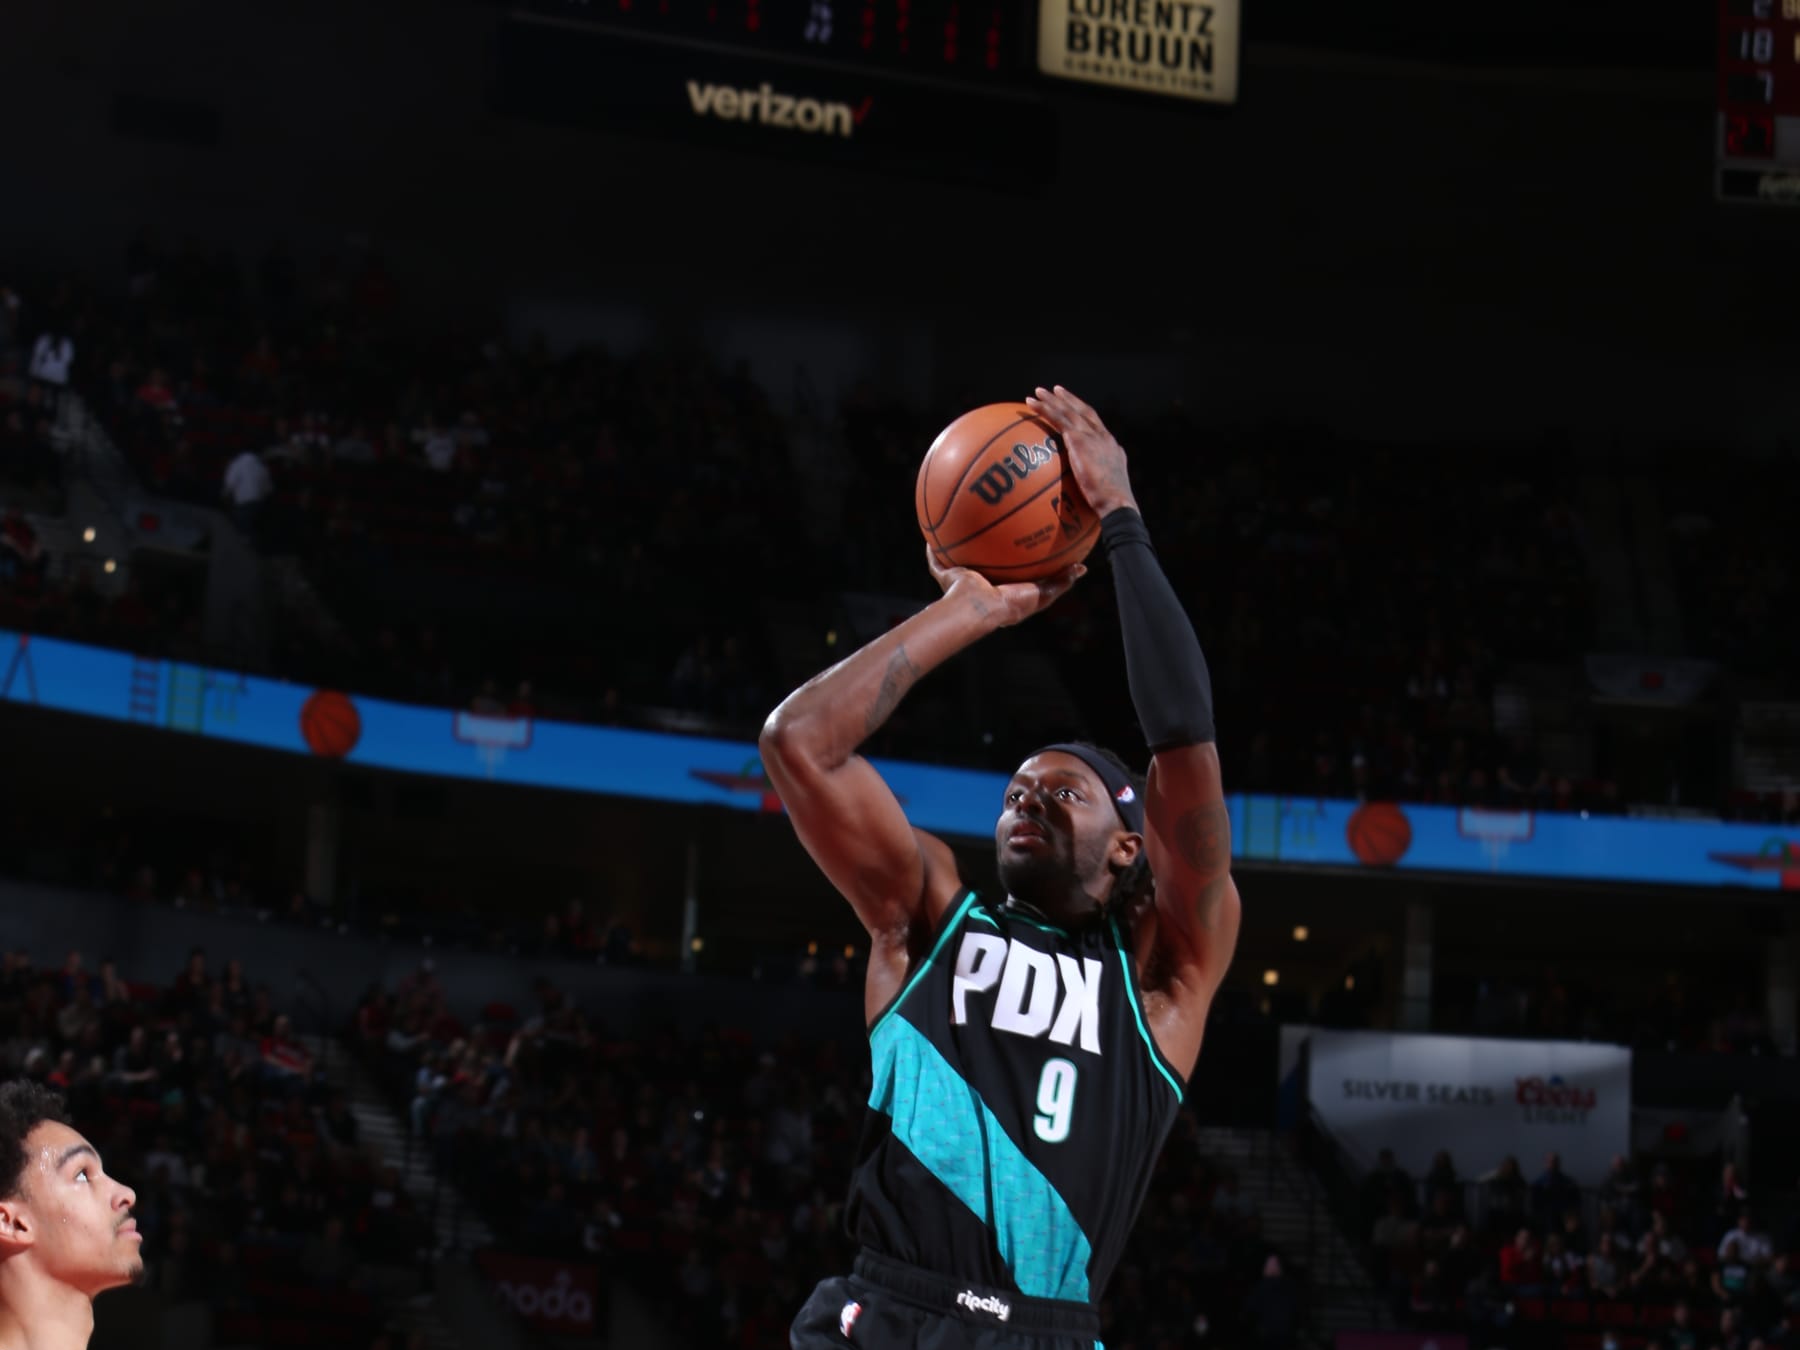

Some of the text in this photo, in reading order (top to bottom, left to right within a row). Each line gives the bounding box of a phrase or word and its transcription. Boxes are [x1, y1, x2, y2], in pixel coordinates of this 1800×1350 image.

[1067, 20, 1212, 73] BRUUN
[686, 79, 853, 138] verizon
[969, 436, 1061, 506] Wilso
[950, 931, 1104, 1056] PDX
[1033, 1057, 1078, 1143] 9
[1342, 1079, 1494, 1105] SILVER SEATS
[956, 1289, 1010, 1322] ripcity
